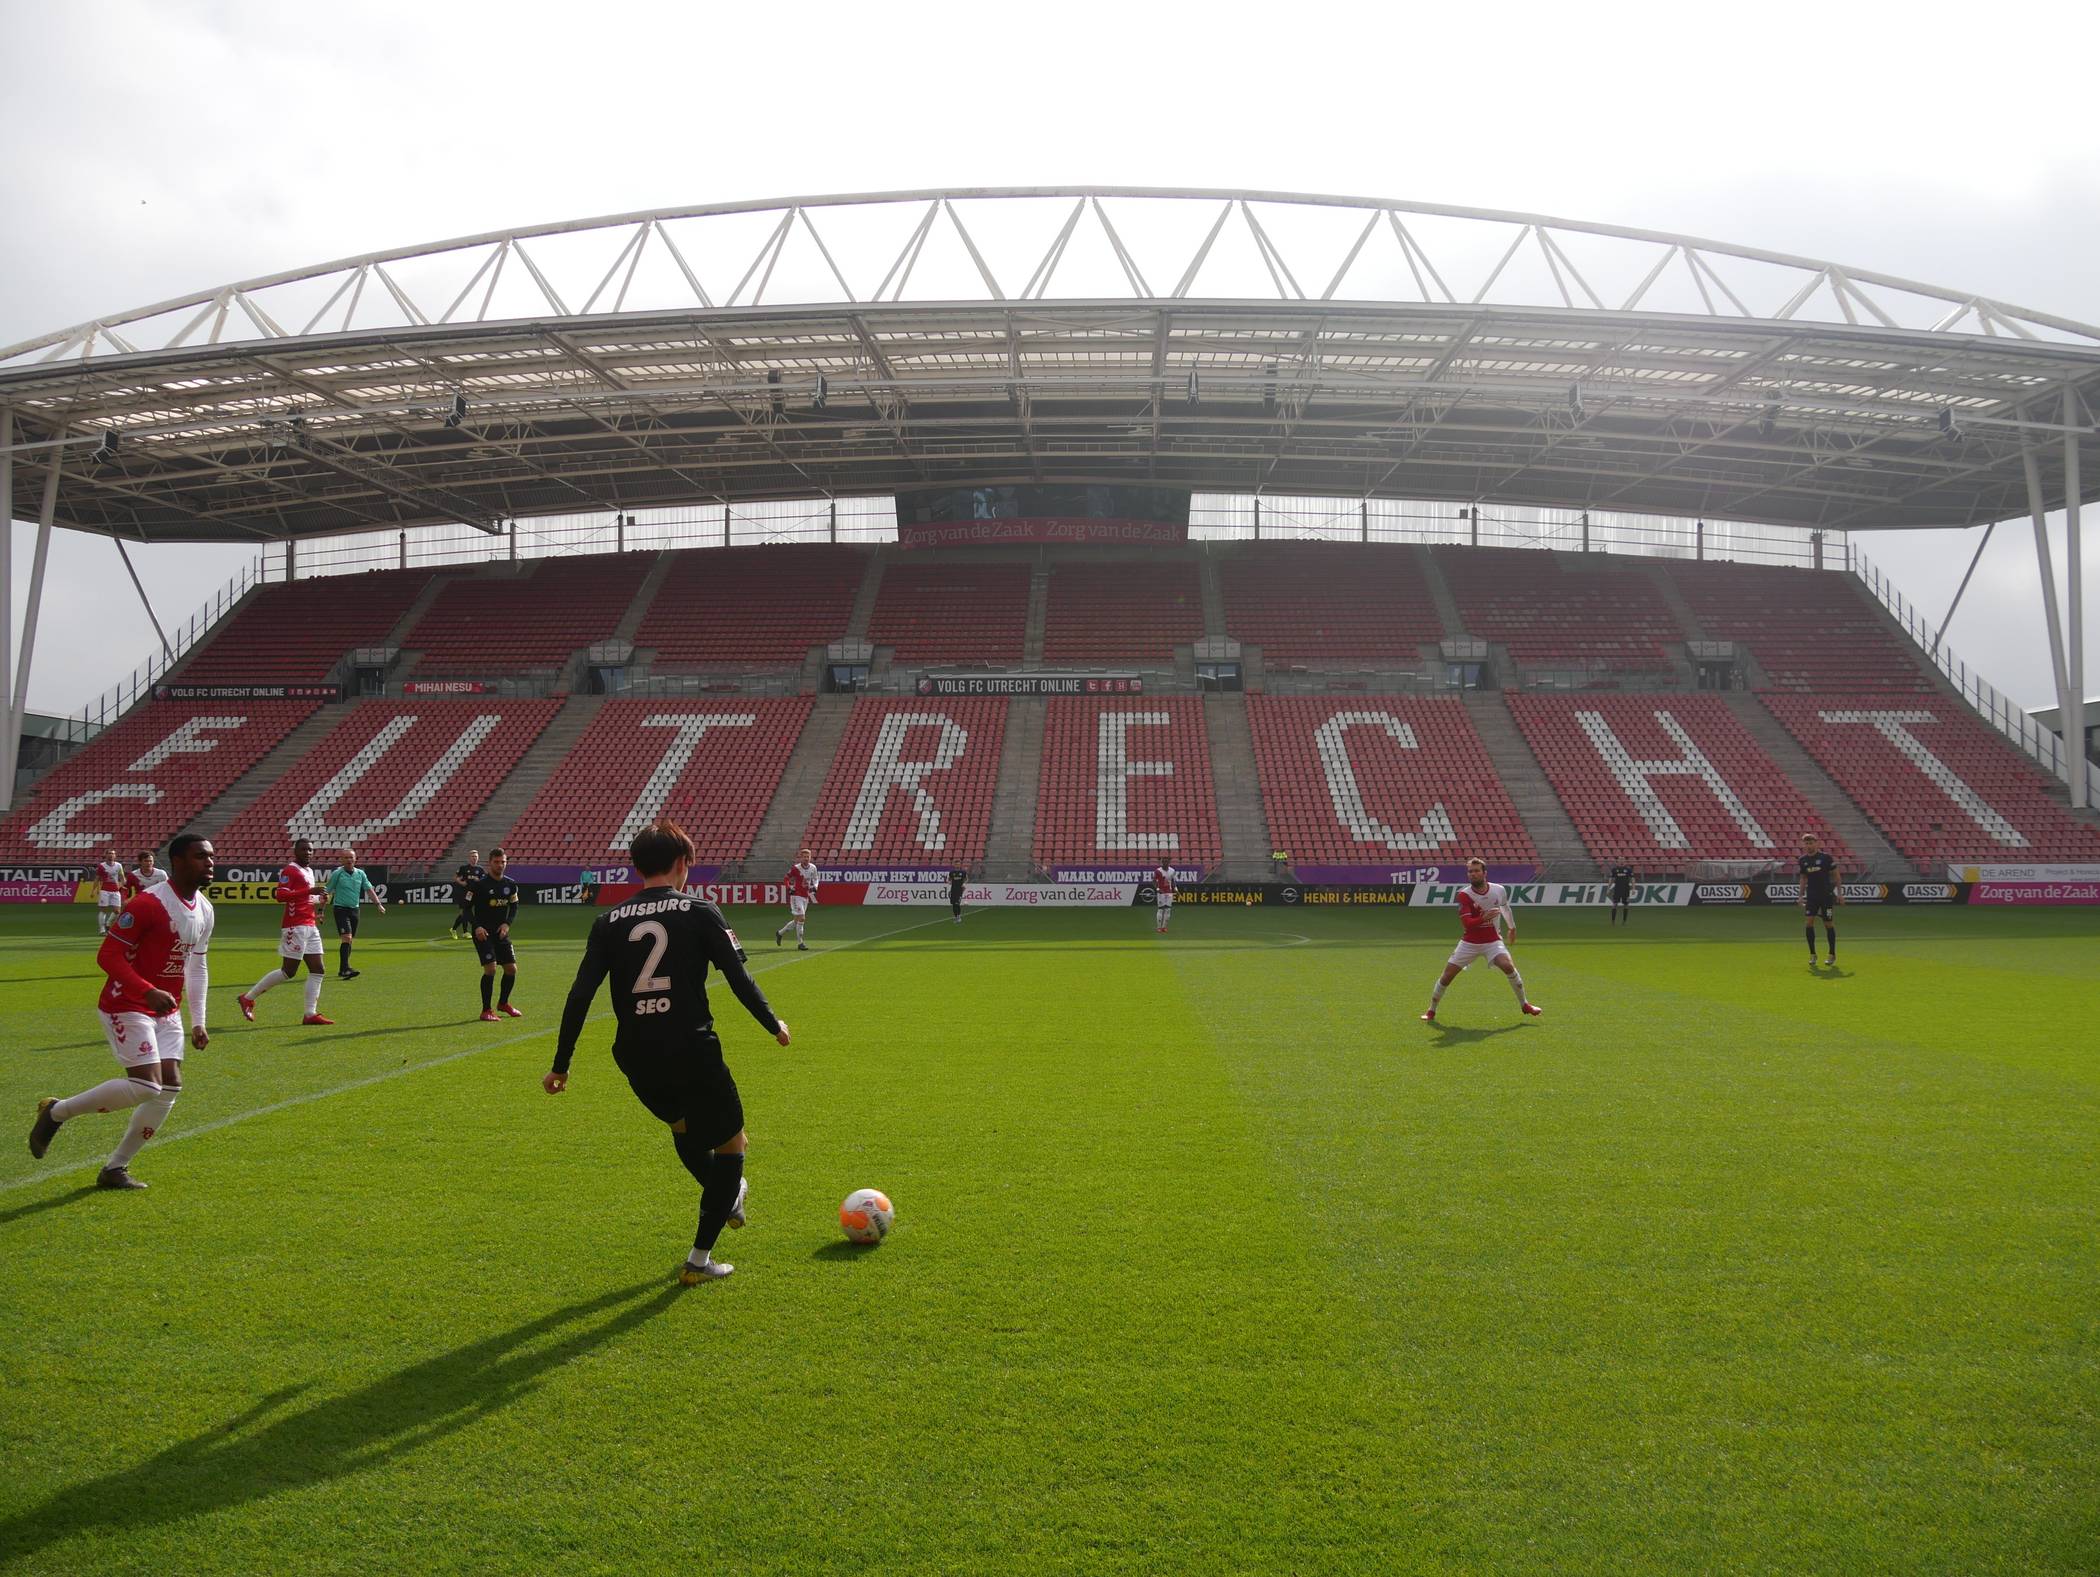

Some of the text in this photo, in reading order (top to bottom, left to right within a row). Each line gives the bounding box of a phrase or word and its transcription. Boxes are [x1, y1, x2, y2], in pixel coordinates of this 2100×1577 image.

[904, 521, 1033, 545] Zorg van de Zaak
[1047, 521, 1180, 541] Zorg van de Zaak
[171, 687, 284, 697] VOLG FC UTRECHT ONLINE
[415, 682, 473, 693] MIHAI NESU
[937, 679, 1080, 693] VOLG FC UTRECHT ONLINE
[0, 869, 83, 881] TALENT
[227, 869, 272, 882] Only
[592, 867, 629, 884] ELE2
[844, 871, 887, 882] OMDAT
[889, 871, 916, 882] HET
[1058, 871, 1094, 882] MAAR
[1097, 871, 1141, 882] OMDAT
[1390, 866, 1440, 884] TELE2
[2000, 869, 2036, 877] AREND
[22, 884, 37, 897] de
[38, 884, 72, 897] Zaak
[404, 884, 454, 903] TELE2
[537, 884, 583, 904] TELE2
[685, 885, 758, 904] MSTEL
[877, 886, 909, 902] Zorg
[911, 889, 937, 900] van
[961, 887, 992, 900] aak
[1006, 887, 1122, 903] Zorg van de Zaak
[1173, 892, 1263, 903] ENRI & HERMAN
[1701, 886, 1739, 897] DASSY
[1770, 886, 1800, 897] DASS
[1907, 886, 1945, 897] DASSY
[1980, 885, 2099, 902] Zorg van de Zaak
[1304, 892, 1405, 904] HENRI & HERMAN
[609, 898, 692, 923] DUISBURG
[628, 920, 672, 994] 2
[635, 997, 672, 1015] SEO
